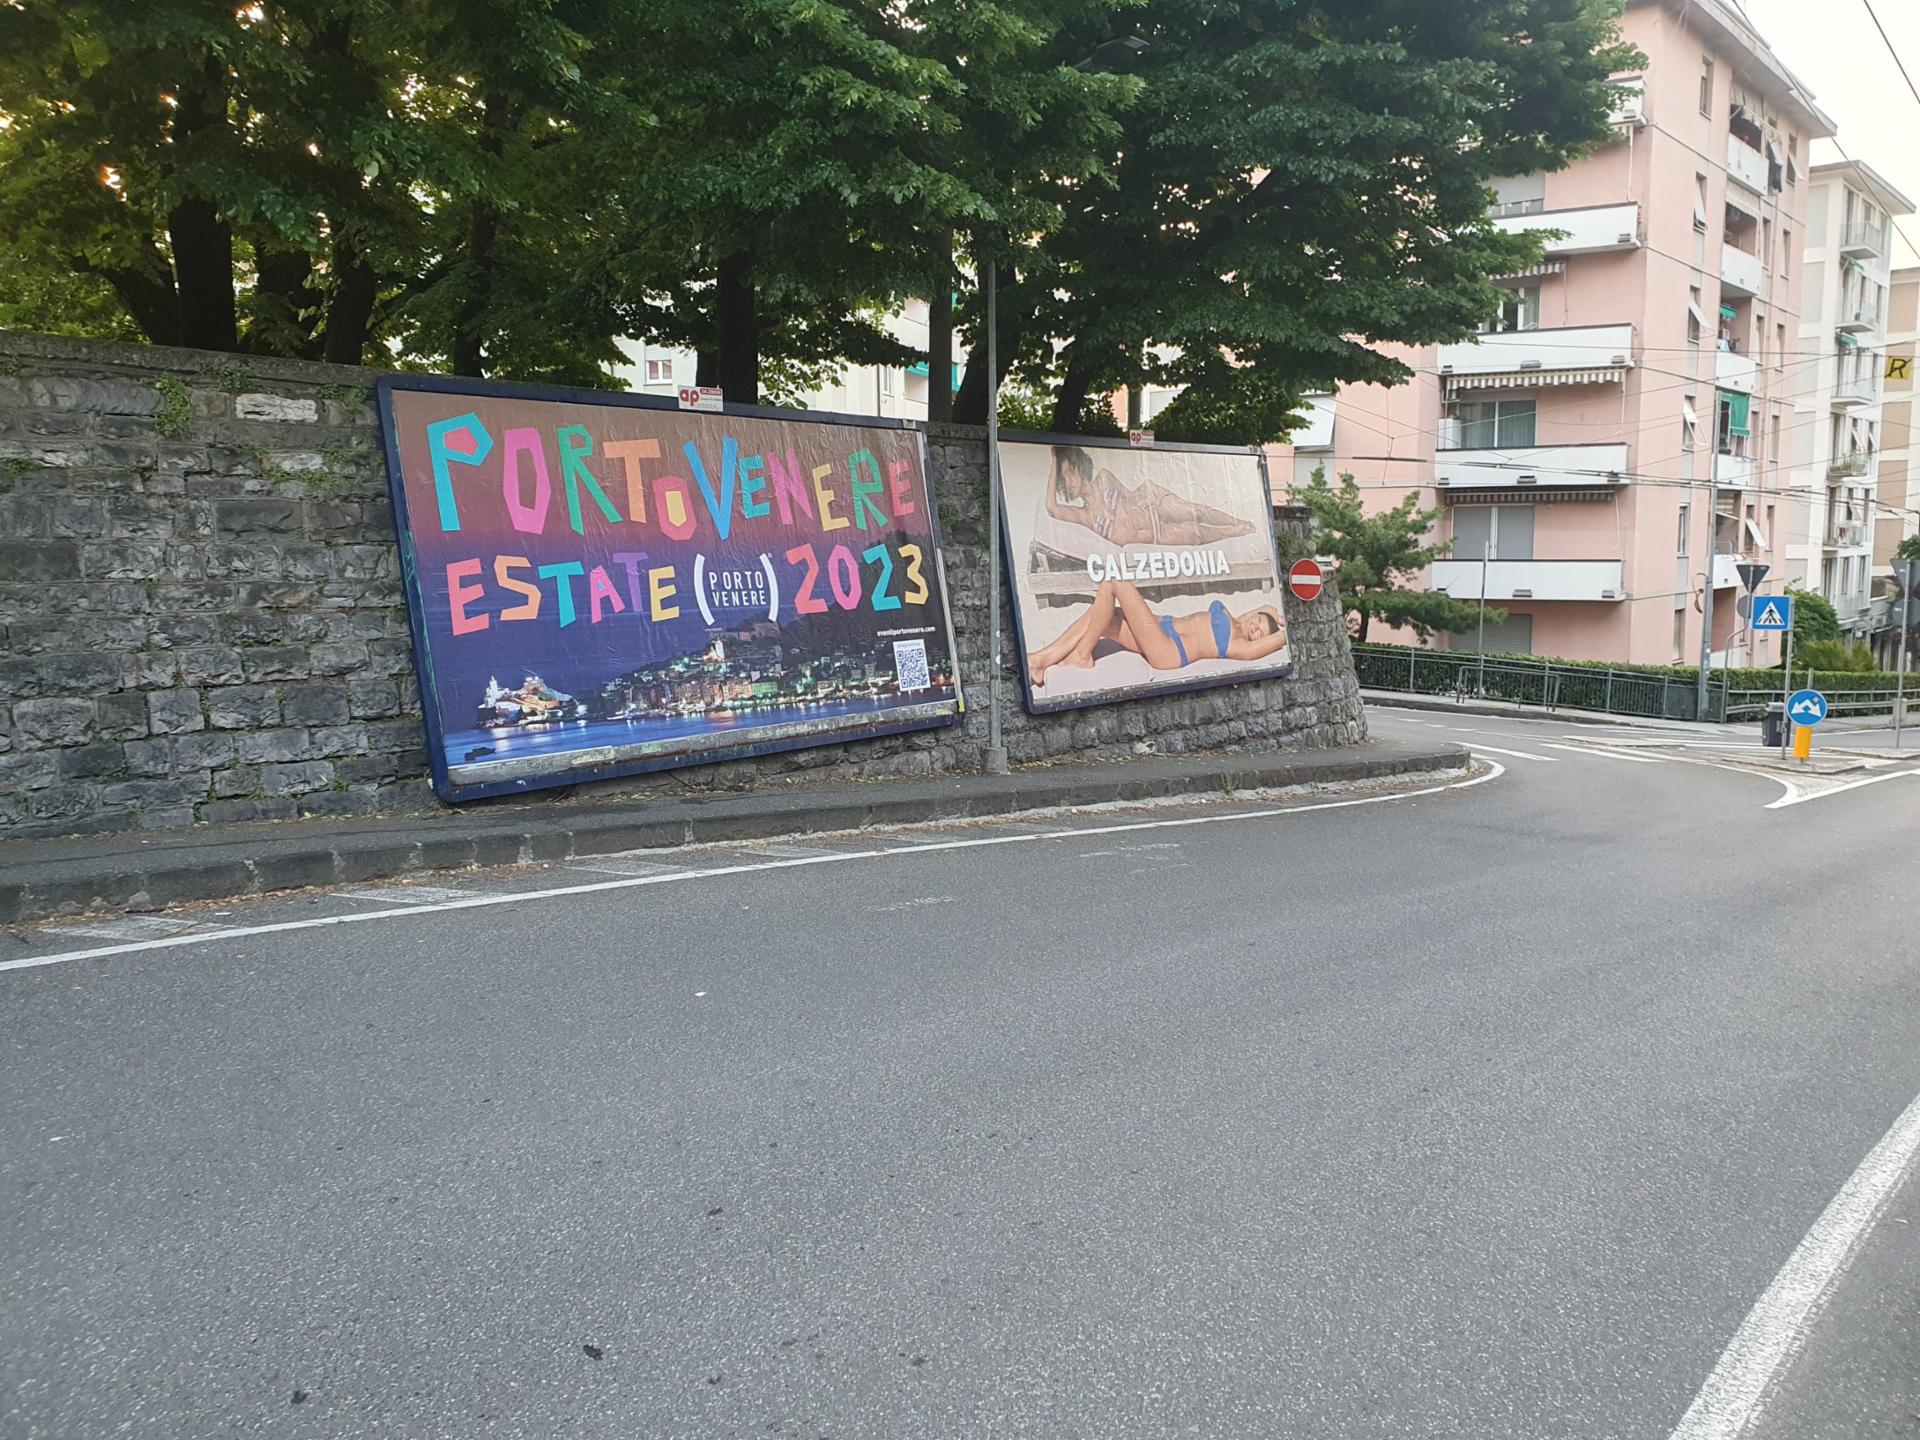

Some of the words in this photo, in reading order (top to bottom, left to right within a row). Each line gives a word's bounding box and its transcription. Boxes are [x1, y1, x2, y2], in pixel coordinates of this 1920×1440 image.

[1087, 550, 1231, 583] CALZEDONIA
[446, 551, 680, 636] ESTATE
[785, 543, 929, 614] 2023
[708, 571, 764, 590] PORTO
[712, 590, 767, 607] VENERE
